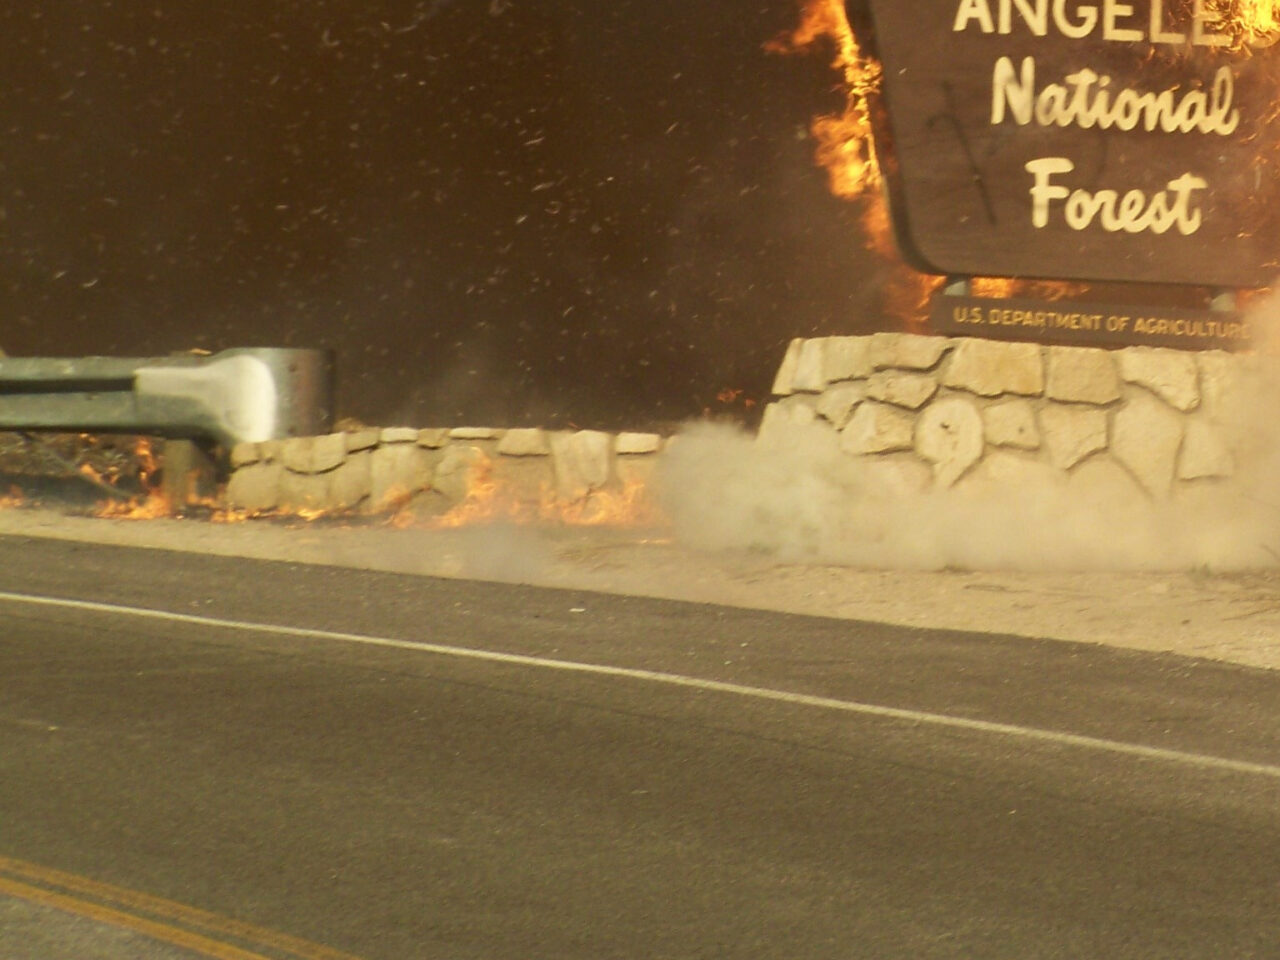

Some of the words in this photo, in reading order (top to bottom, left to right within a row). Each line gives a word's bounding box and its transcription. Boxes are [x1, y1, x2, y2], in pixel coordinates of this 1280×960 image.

[990, 54, 1239, 136] National
[1025, 156, 1207, 235] Forest
[953, 306, 985, 324] U.S.
[988, 309, 1101, 332] DEPARTMENT
[1106, 316, 1131, 332] OF
